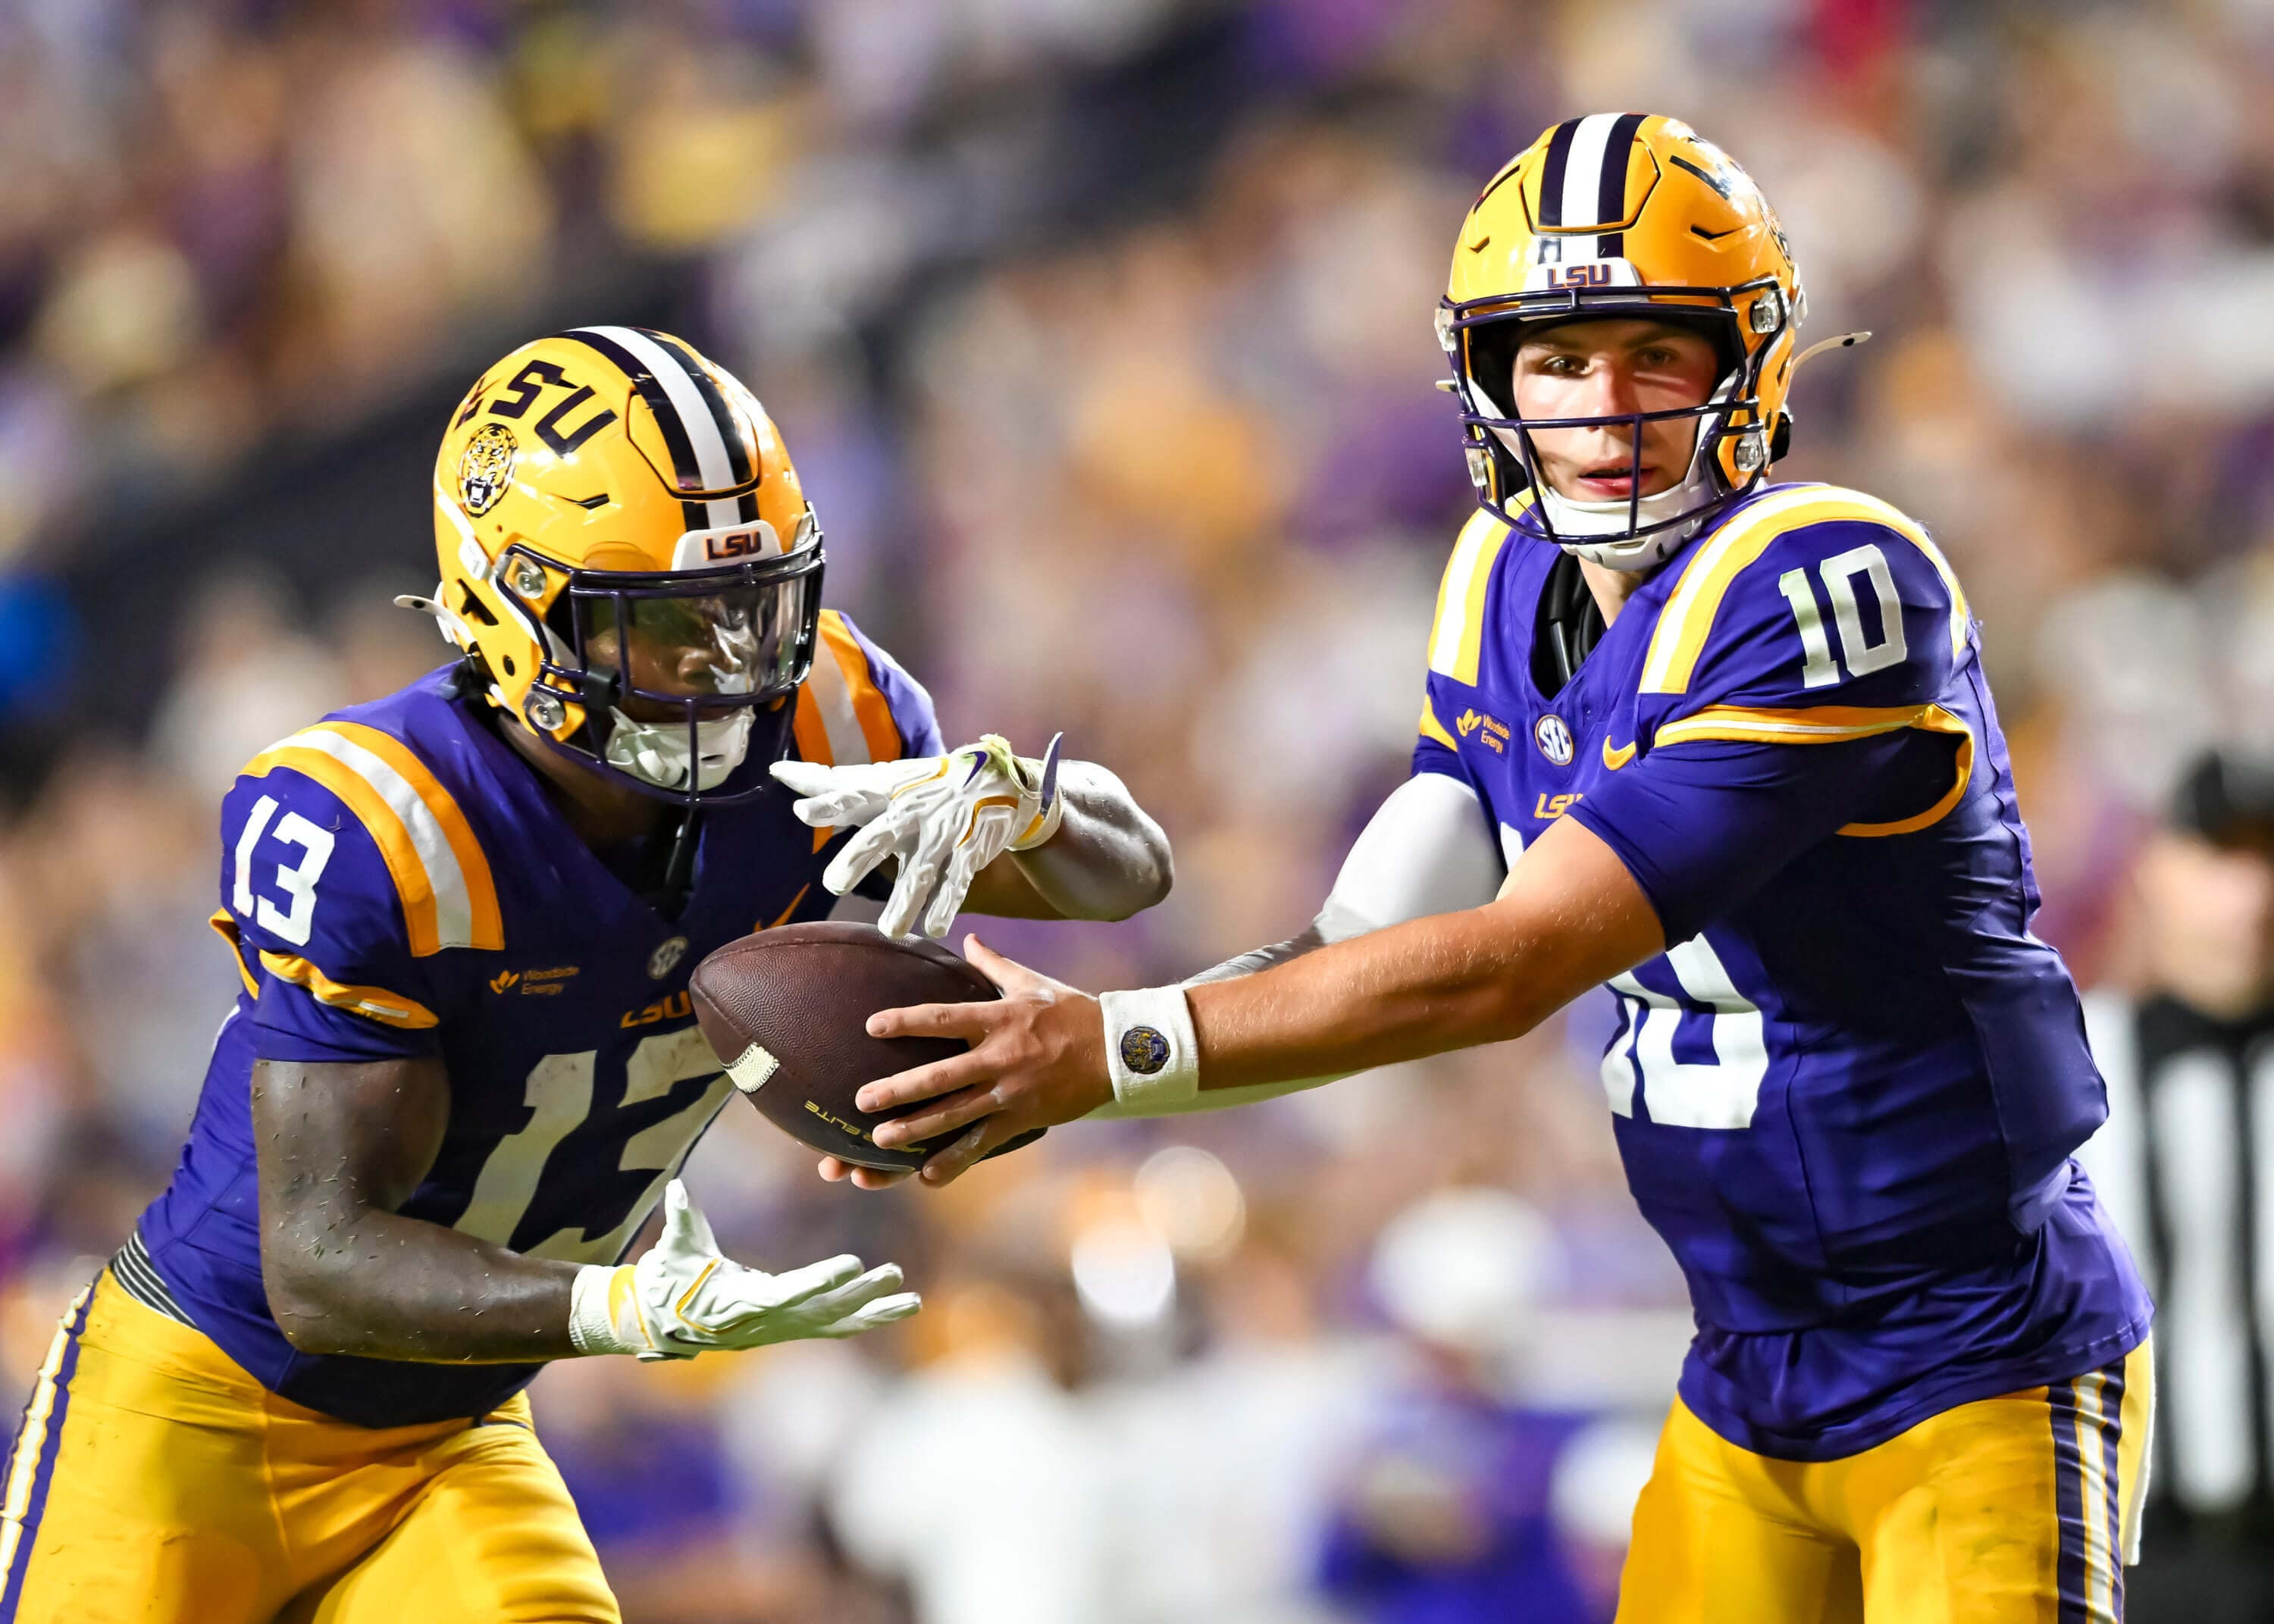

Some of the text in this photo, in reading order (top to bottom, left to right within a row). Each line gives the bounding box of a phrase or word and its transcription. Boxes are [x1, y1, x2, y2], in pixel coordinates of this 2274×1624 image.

[1547, 264, 1611, 289] LSU
[703, 530, 762, 561] LSU
[1778, 543, 1907, 689] 10
[1538, 717, 1571, 761] SEC
[233, 794, 335, 947] 13
[620, 990, 692, 1028] LSU
[804, 1100, 862, 1136] ELITE
[453, 1023, 734, 1266] 13
